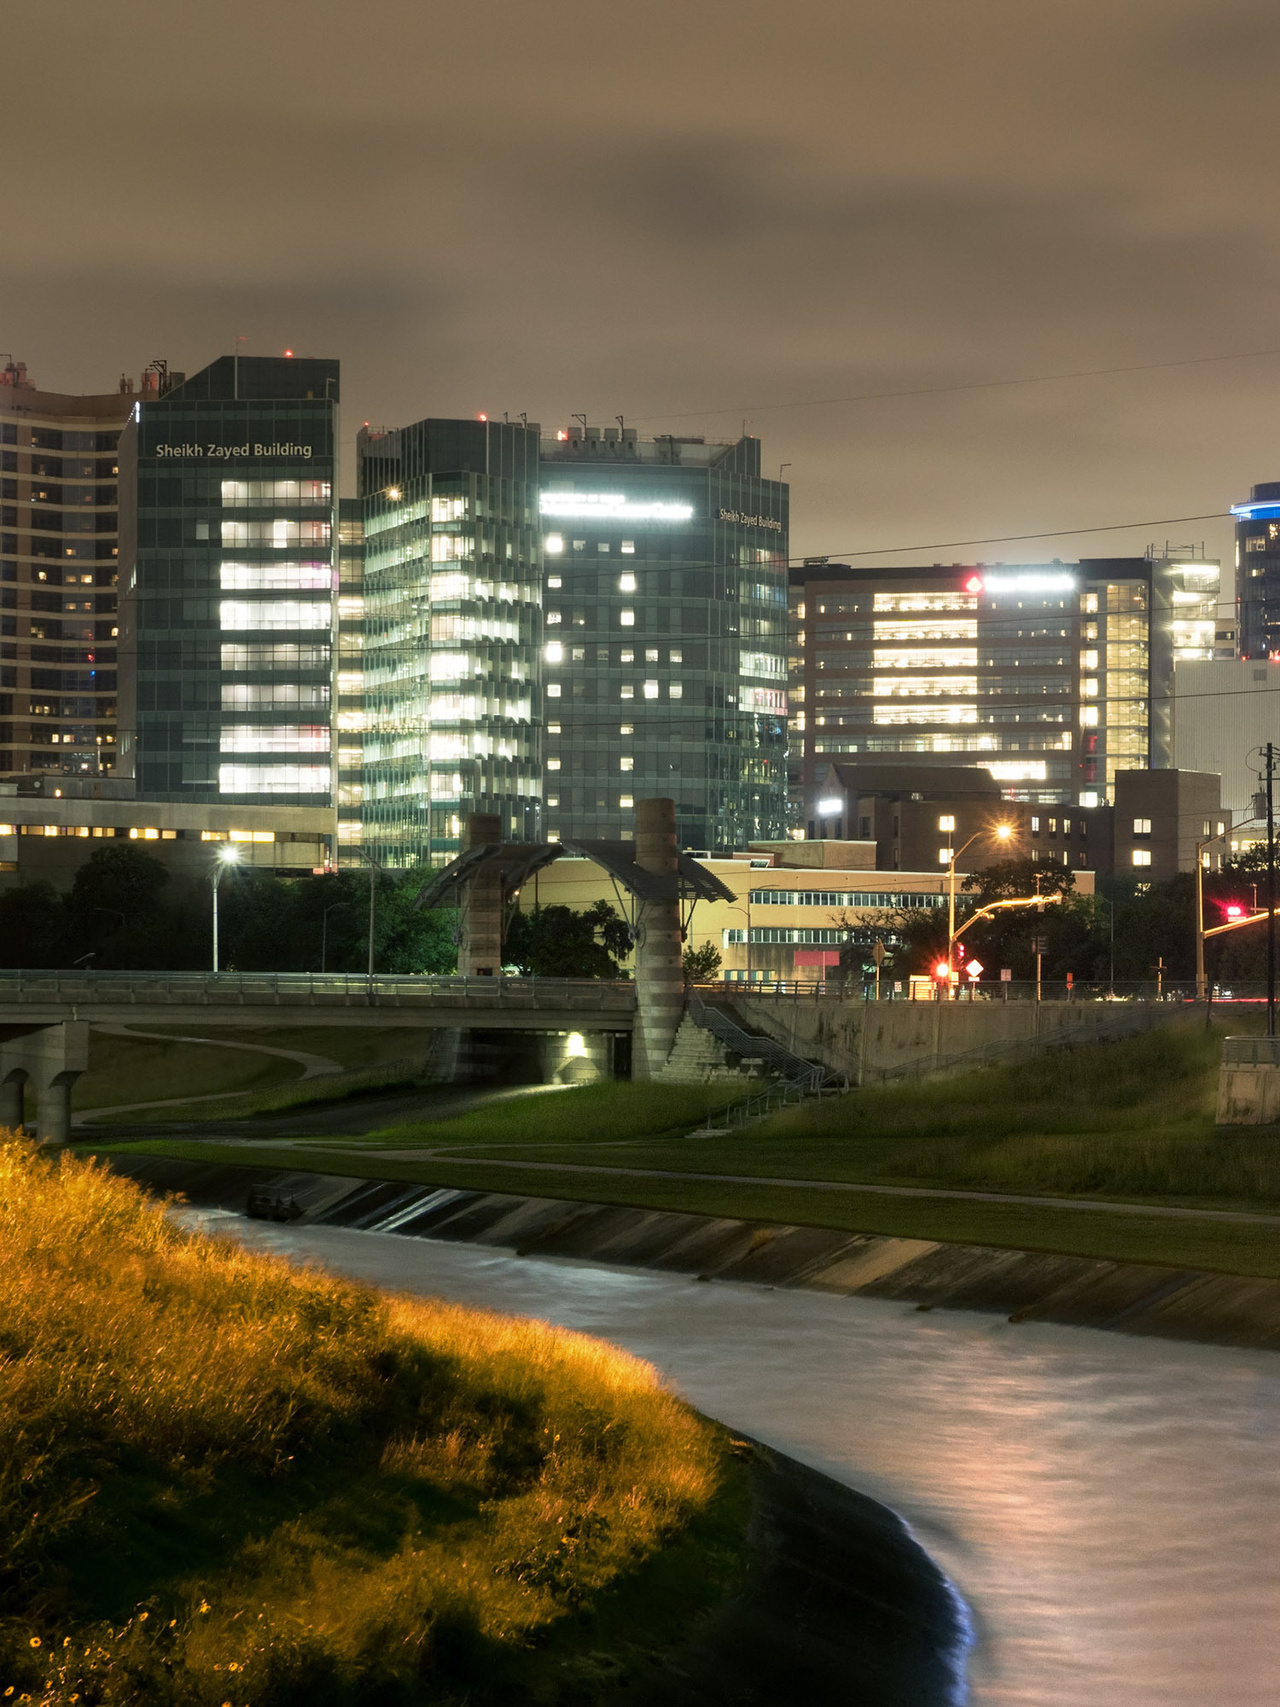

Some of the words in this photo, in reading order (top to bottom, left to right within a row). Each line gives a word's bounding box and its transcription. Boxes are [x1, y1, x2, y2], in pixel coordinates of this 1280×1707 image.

[156, 443, 203, 457] Sheikh
[207, 443, 249, 459] Zayed
[254, 443, 312, 459] Building
[720, 508, 739, 522] Sheikh
[741, 512, 757, 527] Zayed
[759, 516, 781, 533] Building
